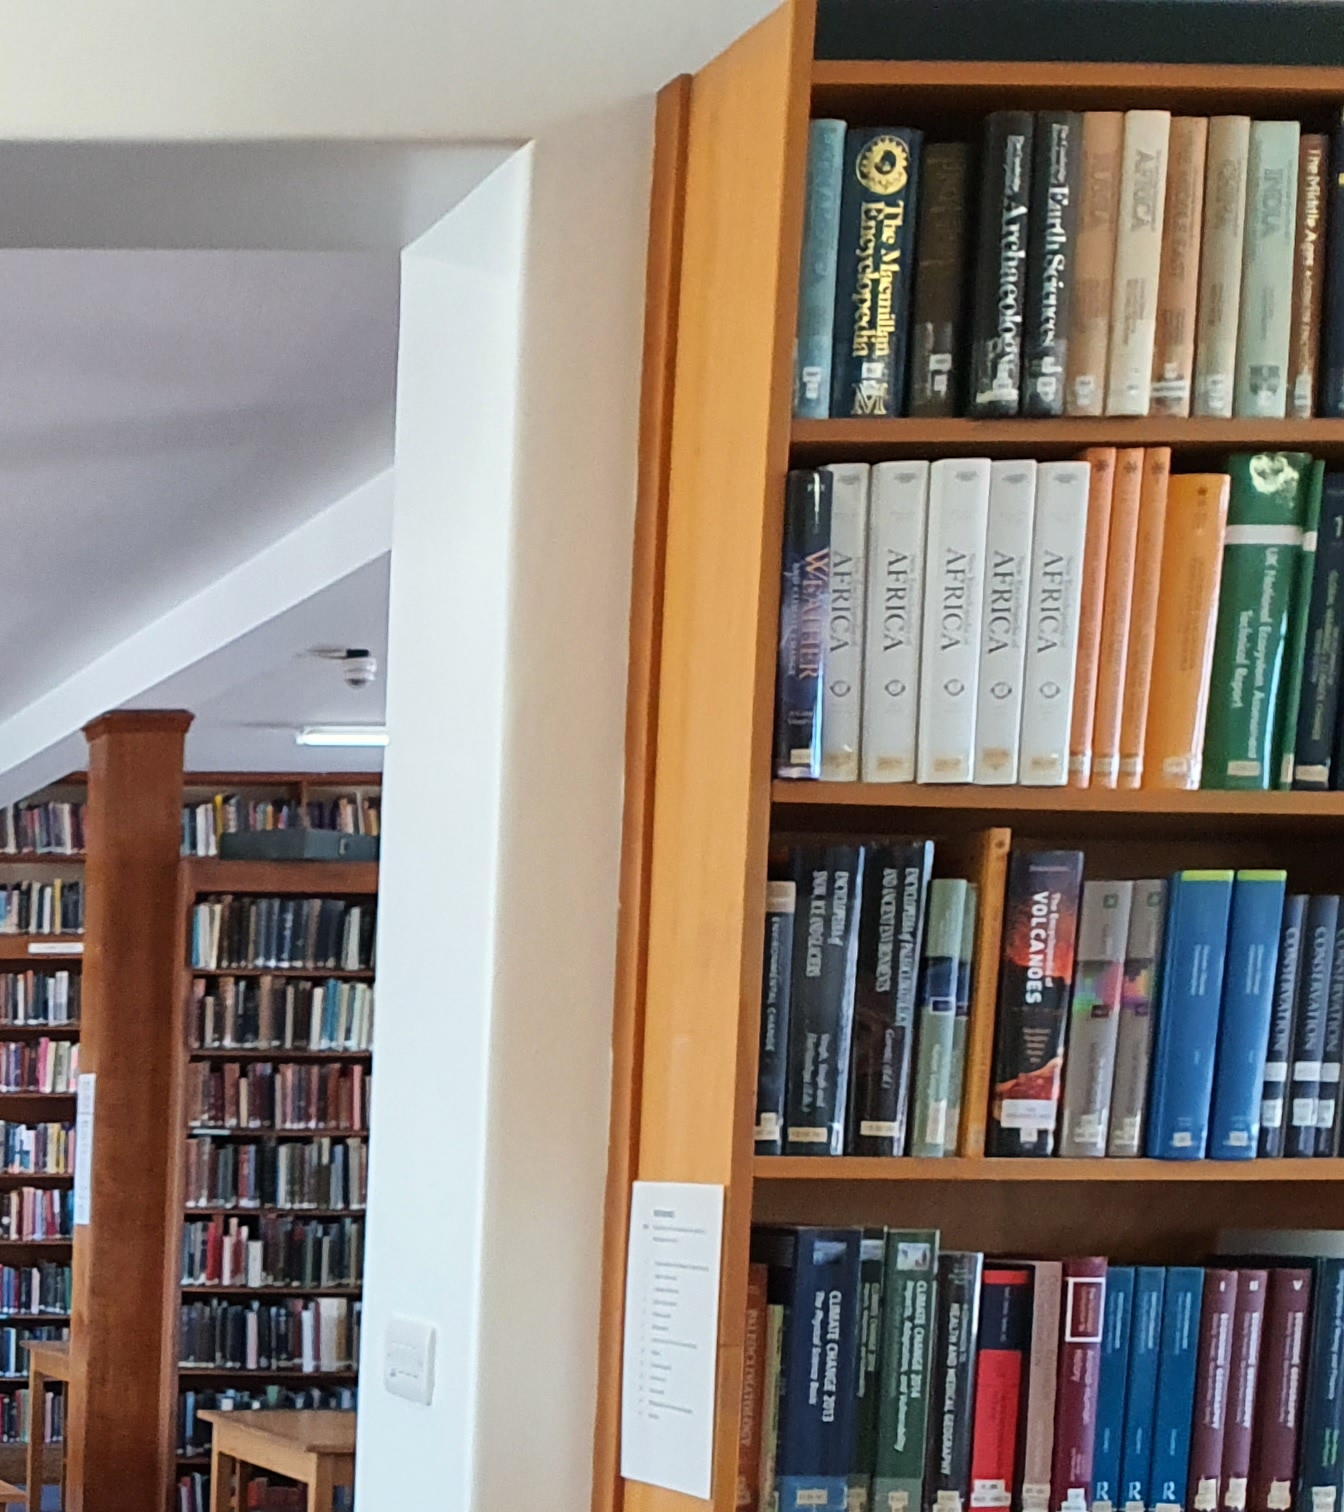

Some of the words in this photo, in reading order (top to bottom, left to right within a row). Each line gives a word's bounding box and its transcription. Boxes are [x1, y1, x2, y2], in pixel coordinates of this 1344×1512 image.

[882, 200, 904, 244] The
[1043, 185, 1070, 250] Earth
[852, 201, 883, 359] Encyclopedia
[873, 248, 900, 359] Macmillan
[994, 200, 1028, 369] Archaeology
[1040, 254, 1065, 347] Sciences
[829, 551, 854, 653] AFRICA
[882, 549, 909, 652] AFRICA
[940, 548, 967, 651] AFRICA
[987, 550, 1014, 655] AFRICA
[1037, 549, 1063, 654] AFRICA
[1265, 548, 1278, 566] UK
[798, 548, 830, 680] WEATHER
[1024, 891, 1049, 1004] VOLCANOES
[1304, 926, 1328, 1051] CONSERVATION
[826, 1290, 843, 1340] CLIMATE
[912, 1327, 924, 1371] CHANGE
[914, 1280, 928, 1325] CLIMATE
[823, 1344, 838, 1392] CHANGE
[946, 1344, 958, 1367] AND
[822, 1395, 835, 1422] 2013
[940, 1414, 954, 1476] GEOGRAPHY
